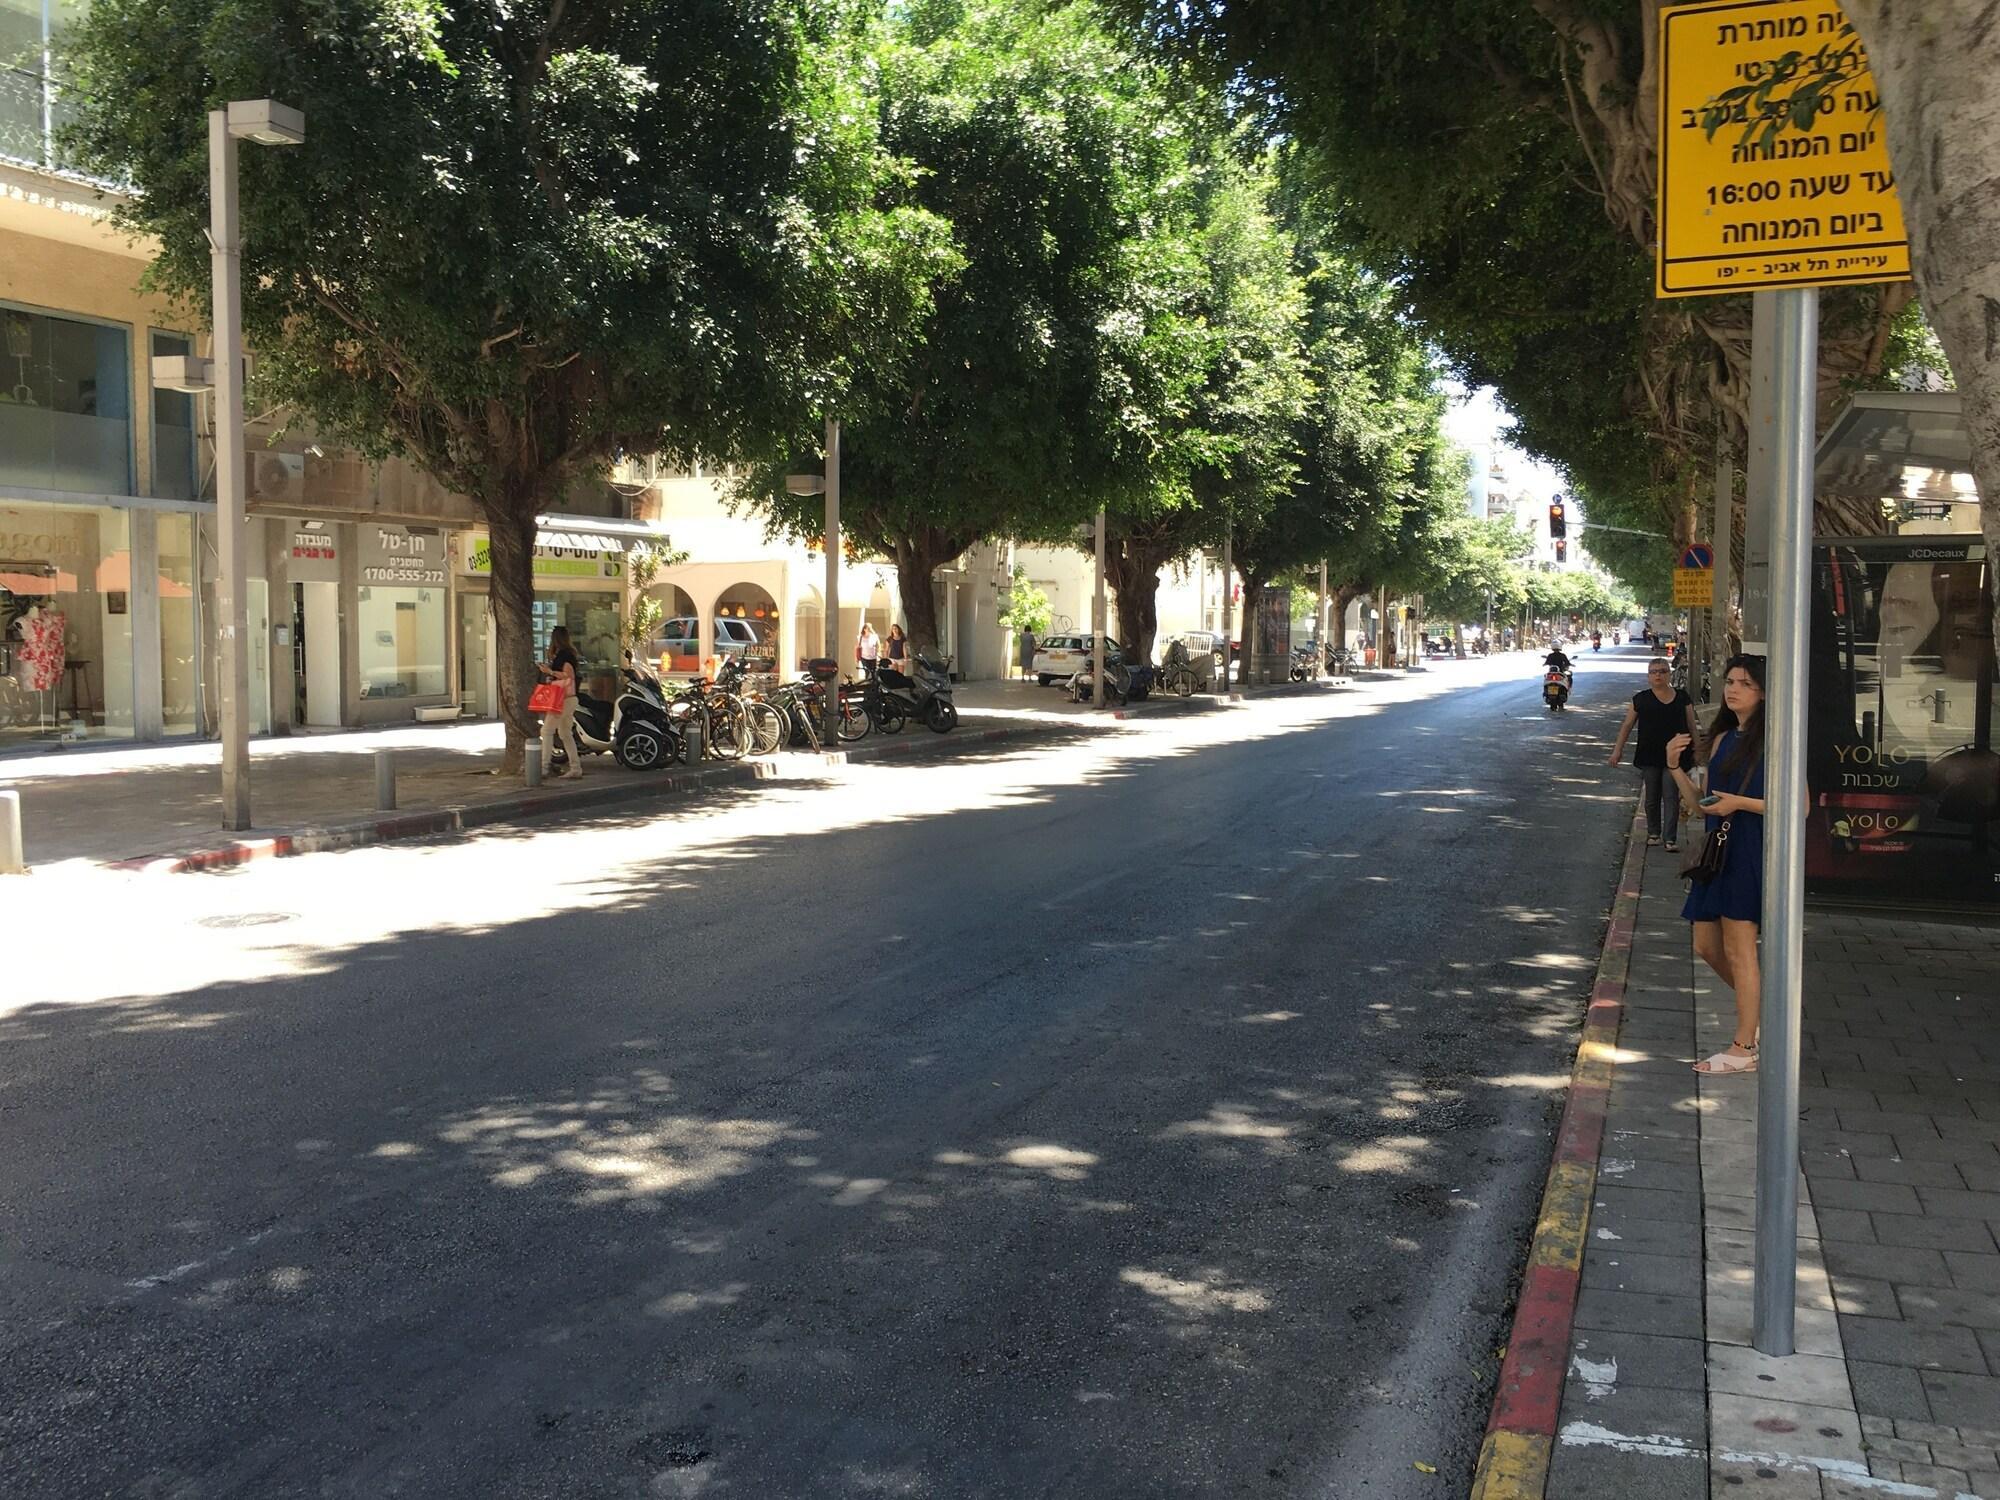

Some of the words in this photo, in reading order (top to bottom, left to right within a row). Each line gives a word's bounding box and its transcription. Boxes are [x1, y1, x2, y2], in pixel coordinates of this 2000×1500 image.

[1717, 16, 1808, 46] מותרת
[1816, 12, 1843, 34] יה
[1731, 135, 1830, 163] המנוחה
[1839, 131, 1876, 153] יום
[1707, 180, 1781, 205] 16:00
[1789, 174, 1850, 200] שעה
[1860, 171, 1895, 194] עד
[1722, 216, 1820, 244] המנוחה
[1830, 212, 1883, 235] ביום
[1717, 265, 1740, 278] יפו
[1763, 262, 1801, 274] אביב
[1807, 257, 1829, 271] תל
[1836, 255, 1888, 269] עיריית
[296, 534, 332, 547] מעבדה
[378, 529, 425, 554] חן-טל
[389, 557, 424, 567] מחשבים
[1908, 547, 1965, 558] JCDecaux
[363, 568, 444, 582] 1700-555-272
[1833, 744, 1911, 768] YOLO
[1842, 772, 1900, 788] שכבות
[1846, 812, 1899, 831] YOLO
